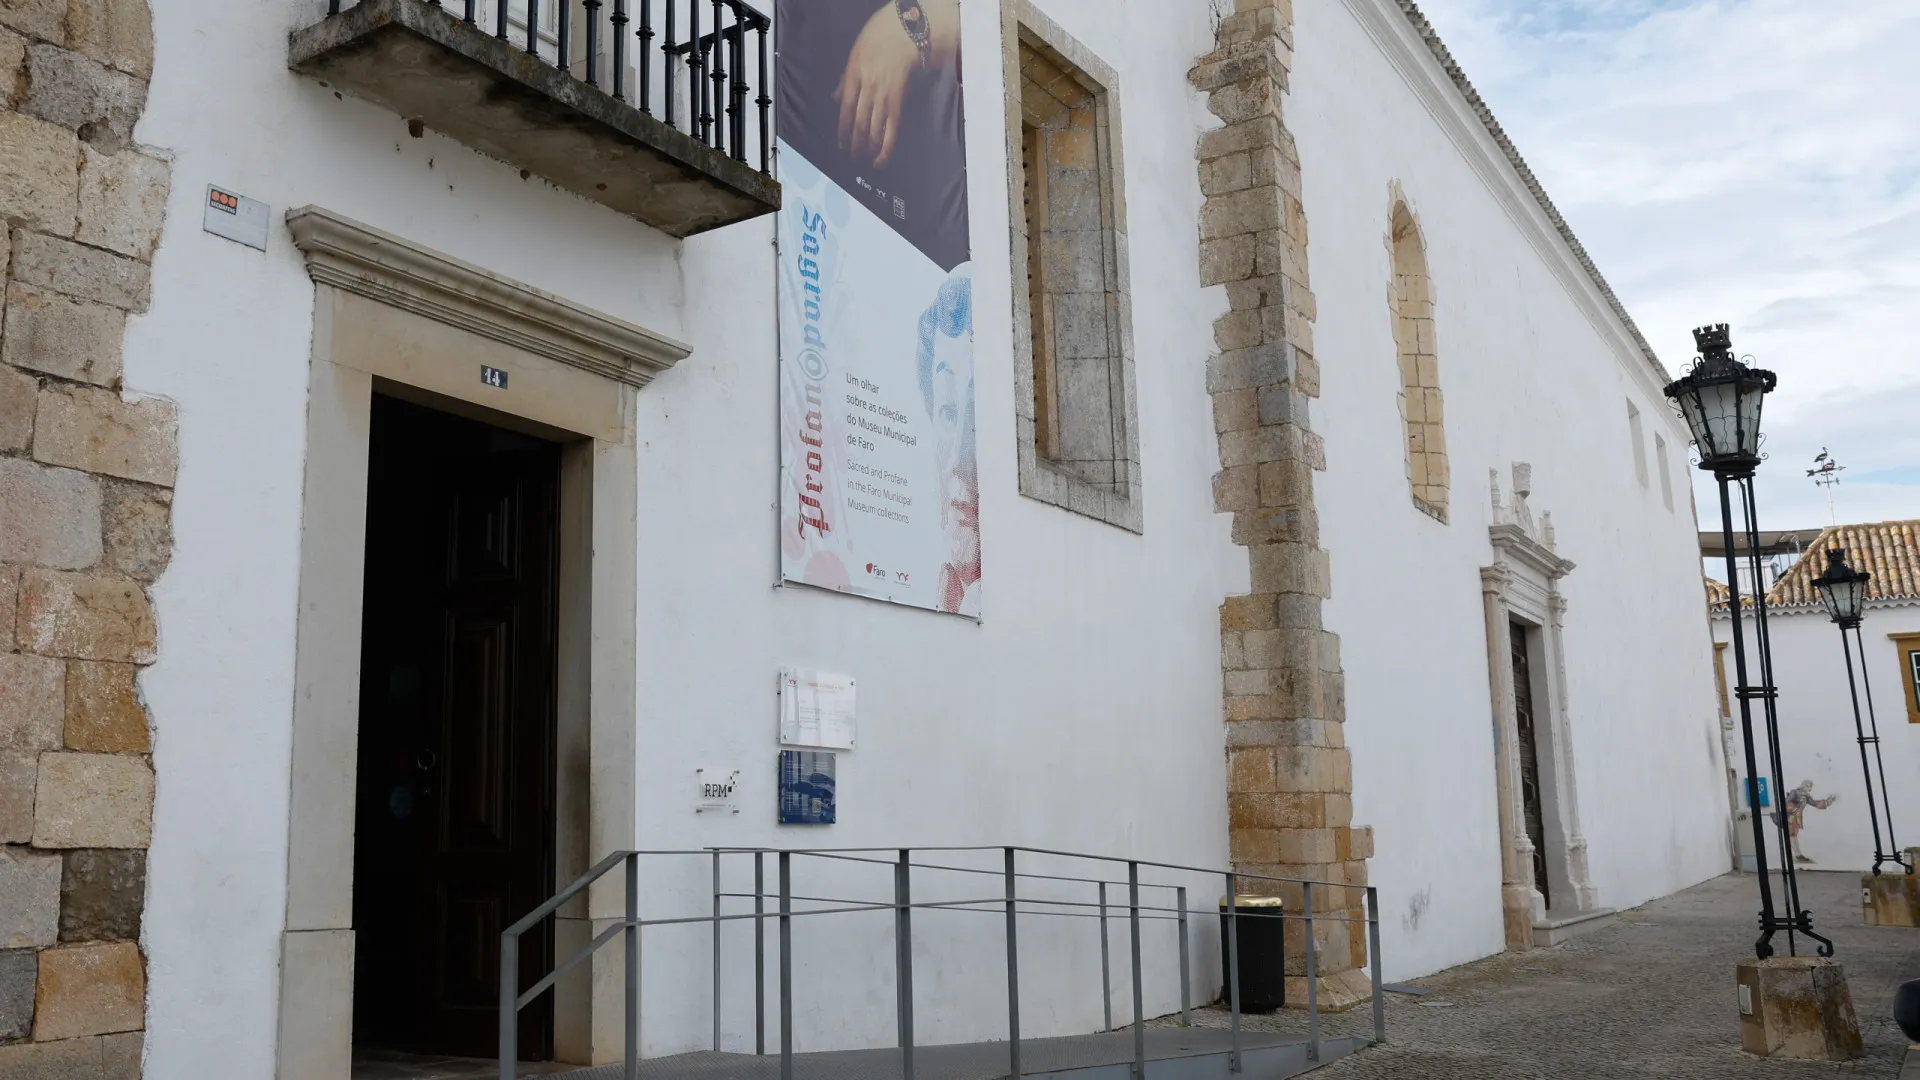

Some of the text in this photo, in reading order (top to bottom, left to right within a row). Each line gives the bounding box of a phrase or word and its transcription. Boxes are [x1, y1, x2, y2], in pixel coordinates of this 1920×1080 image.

[210, 200, 236, 214] SECURITAS
[484, 367, 500, 387] 14
[846, 372, 879, 394] Um olhar
[846, 394, 908, 424] sobre as coleções
[846, 413, 917, 447] do Museu Municipal
[847, 433, 875, 452] de Faro
[847, 458, 908, 487] Sacred and Profane
[847, 478, 912, 508] in the Faro Municipal
[847, 497, 910, 524] Museum collections
[873, 564, 886, 577] Faro
[704, 783, 728, 798] RPM
